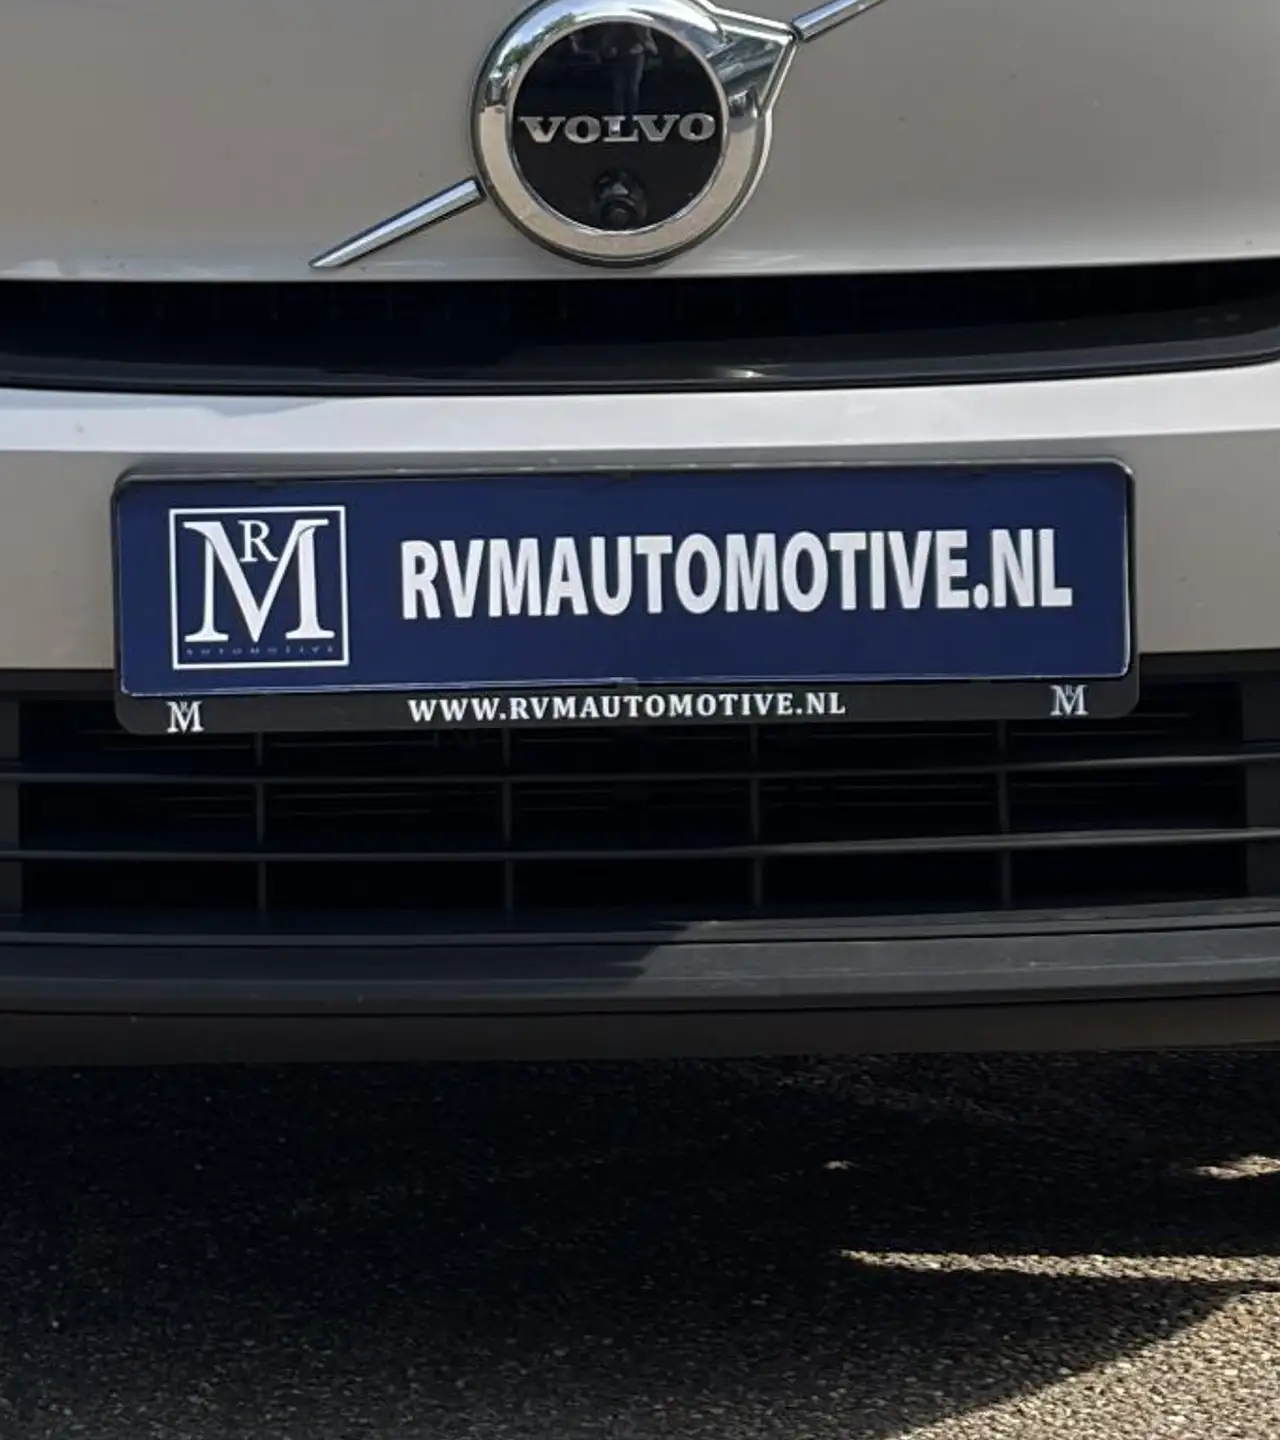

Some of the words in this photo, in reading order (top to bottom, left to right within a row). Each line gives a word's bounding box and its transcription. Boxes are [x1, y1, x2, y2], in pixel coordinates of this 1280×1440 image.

[516, 112, 717, 144] VOLVO
[400, 527, 1073, 620] RVMAUTOMOTIVE.NL
[408, 692, 847, 723] WWW.RVMAUTOMOTIVE.NL
